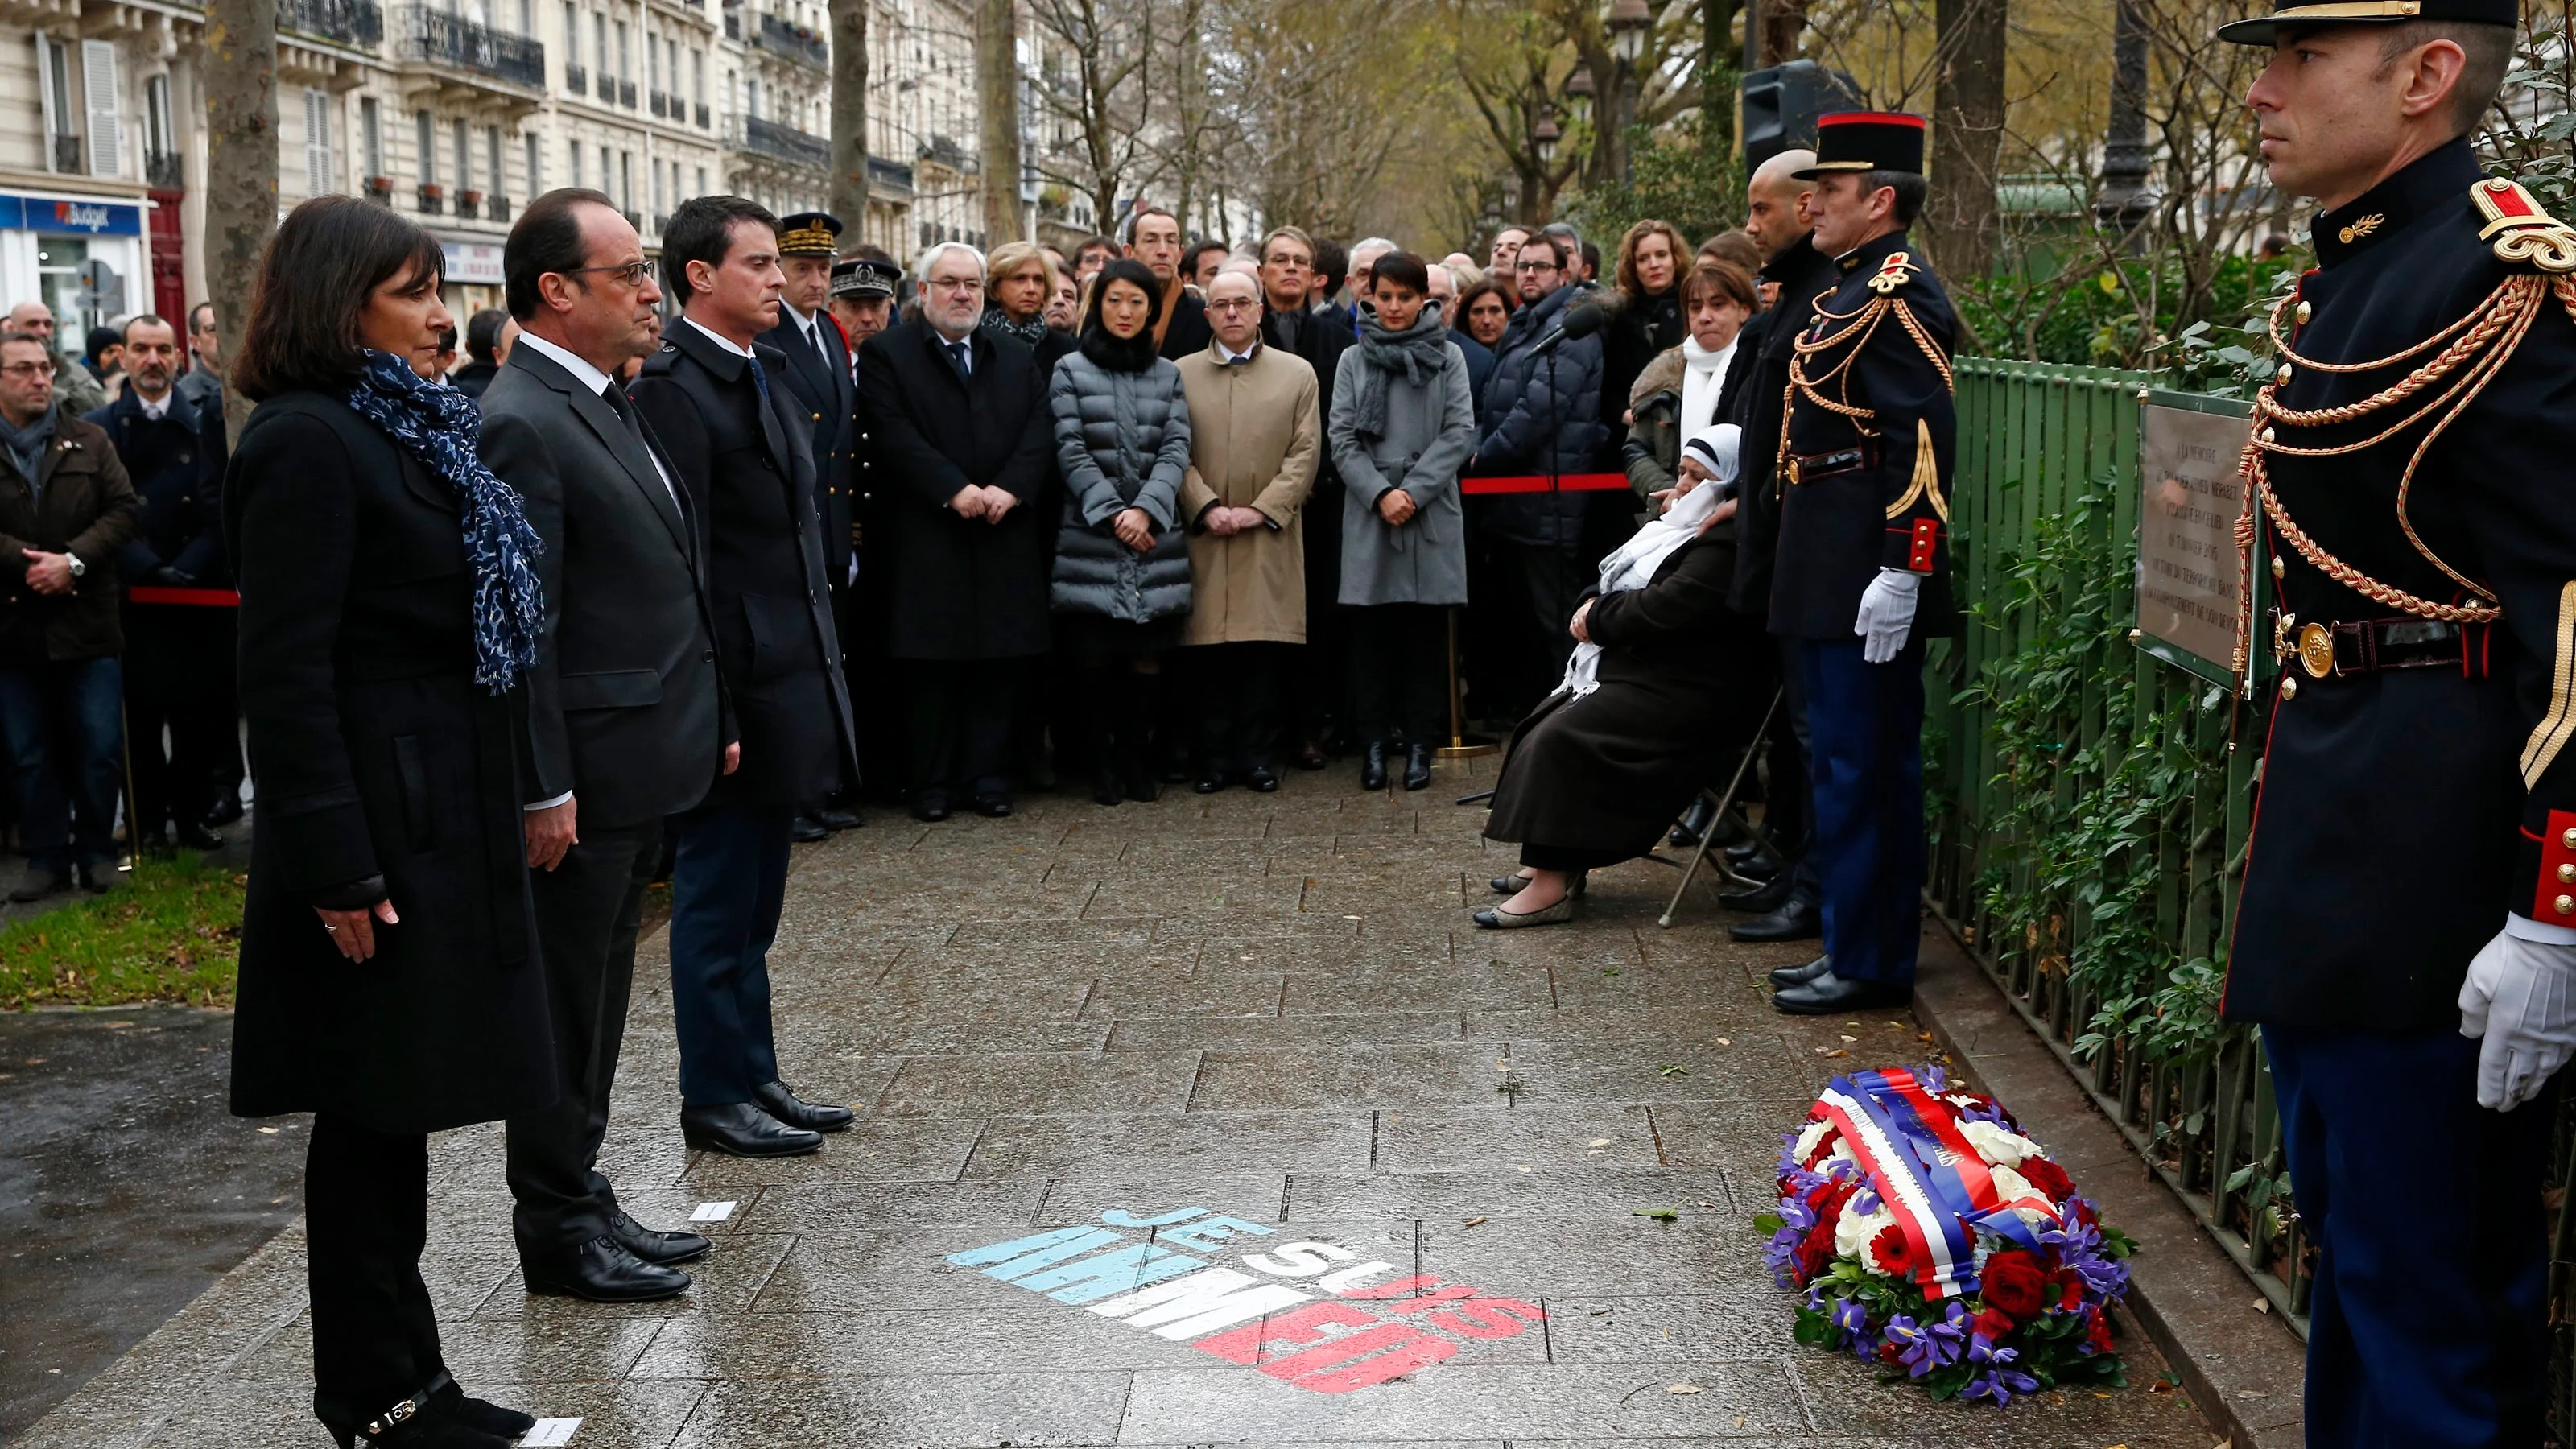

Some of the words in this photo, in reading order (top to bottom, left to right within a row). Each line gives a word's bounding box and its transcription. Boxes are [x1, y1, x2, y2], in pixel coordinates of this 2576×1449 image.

[70, 202, 109, 233] Budget
[943, 1224, 1459, 1393] AHMED
[1101, 1208, 1277, 1252] JE
[1241, 1242, 1550, 1339] SUIS
